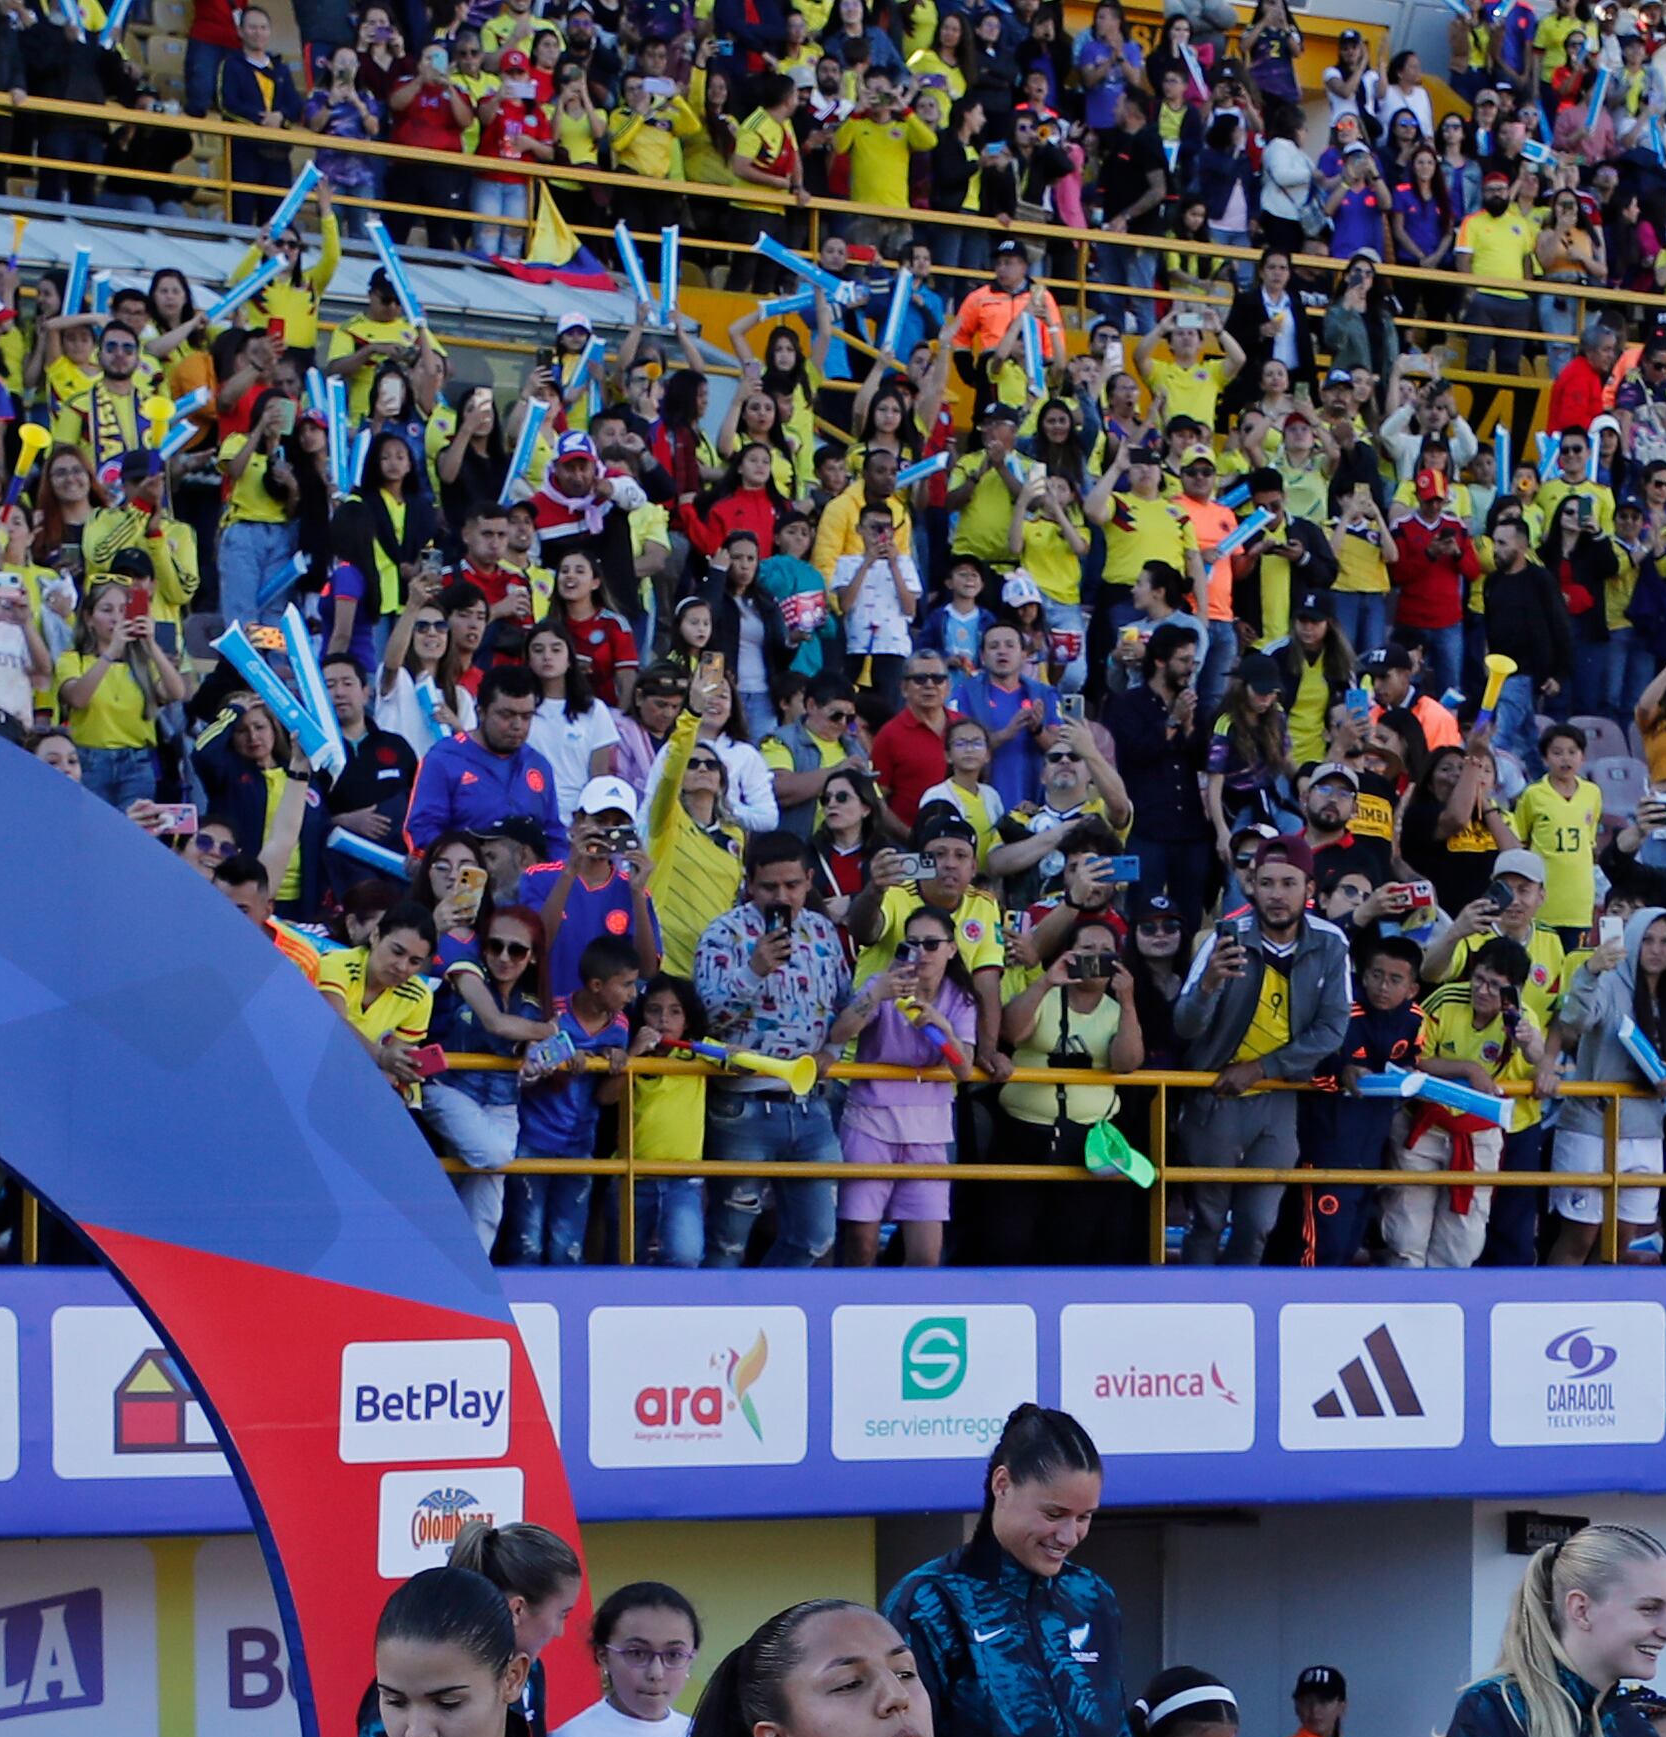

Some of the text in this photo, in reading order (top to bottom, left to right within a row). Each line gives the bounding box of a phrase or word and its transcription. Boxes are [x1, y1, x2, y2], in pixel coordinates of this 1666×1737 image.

[1555, 827, 1580, 853] 13
[1094, 1366, 1204, 1398] avianca
[1546, 1382, 1615, 1412] CARACOL
[354, 1378, 505, 1428] BetPlay
[634, 1386, 723, 1427] ara
[864, 1414, 1004, 1443] servientrega
